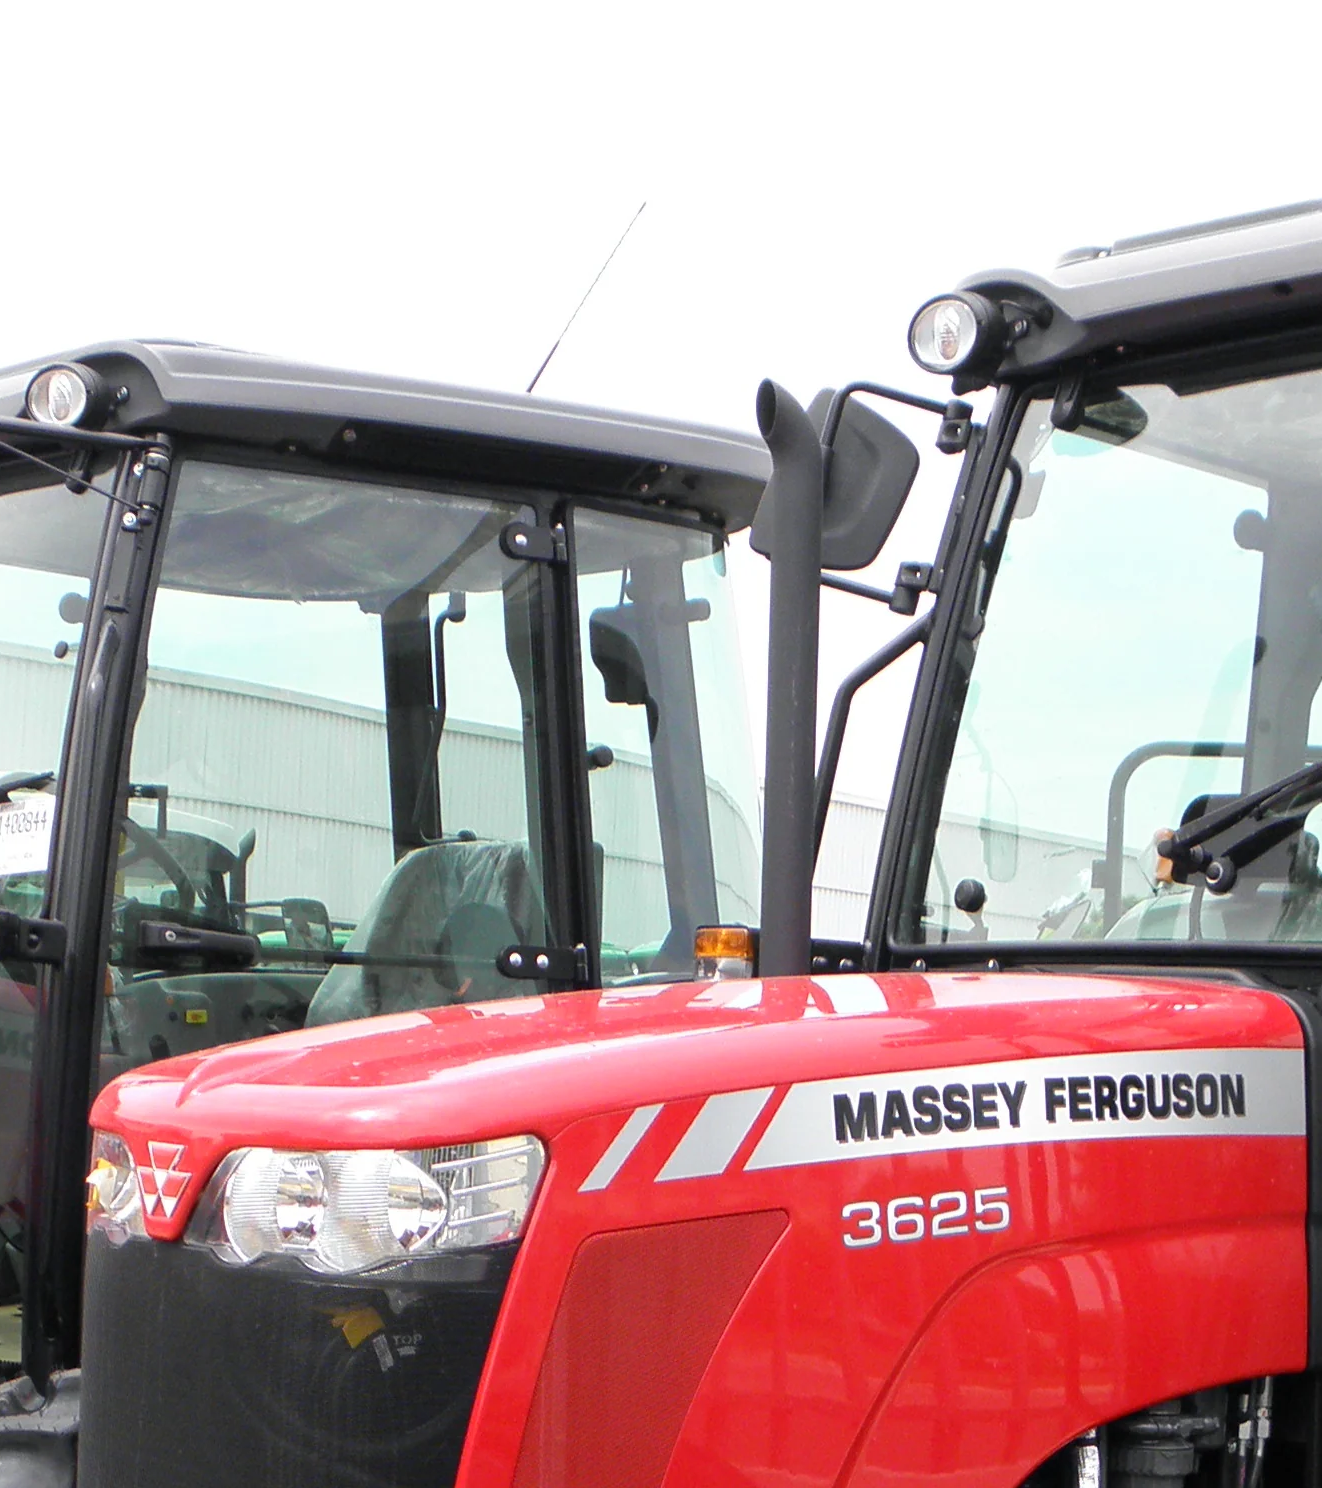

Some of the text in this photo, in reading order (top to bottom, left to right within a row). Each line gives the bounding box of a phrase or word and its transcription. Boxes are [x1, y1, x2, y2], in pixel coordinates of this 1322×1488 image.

[832, 1073, 1246, 1144] MASSEY FERGUSON
[842, 1186, 1012, 1250] 3625
